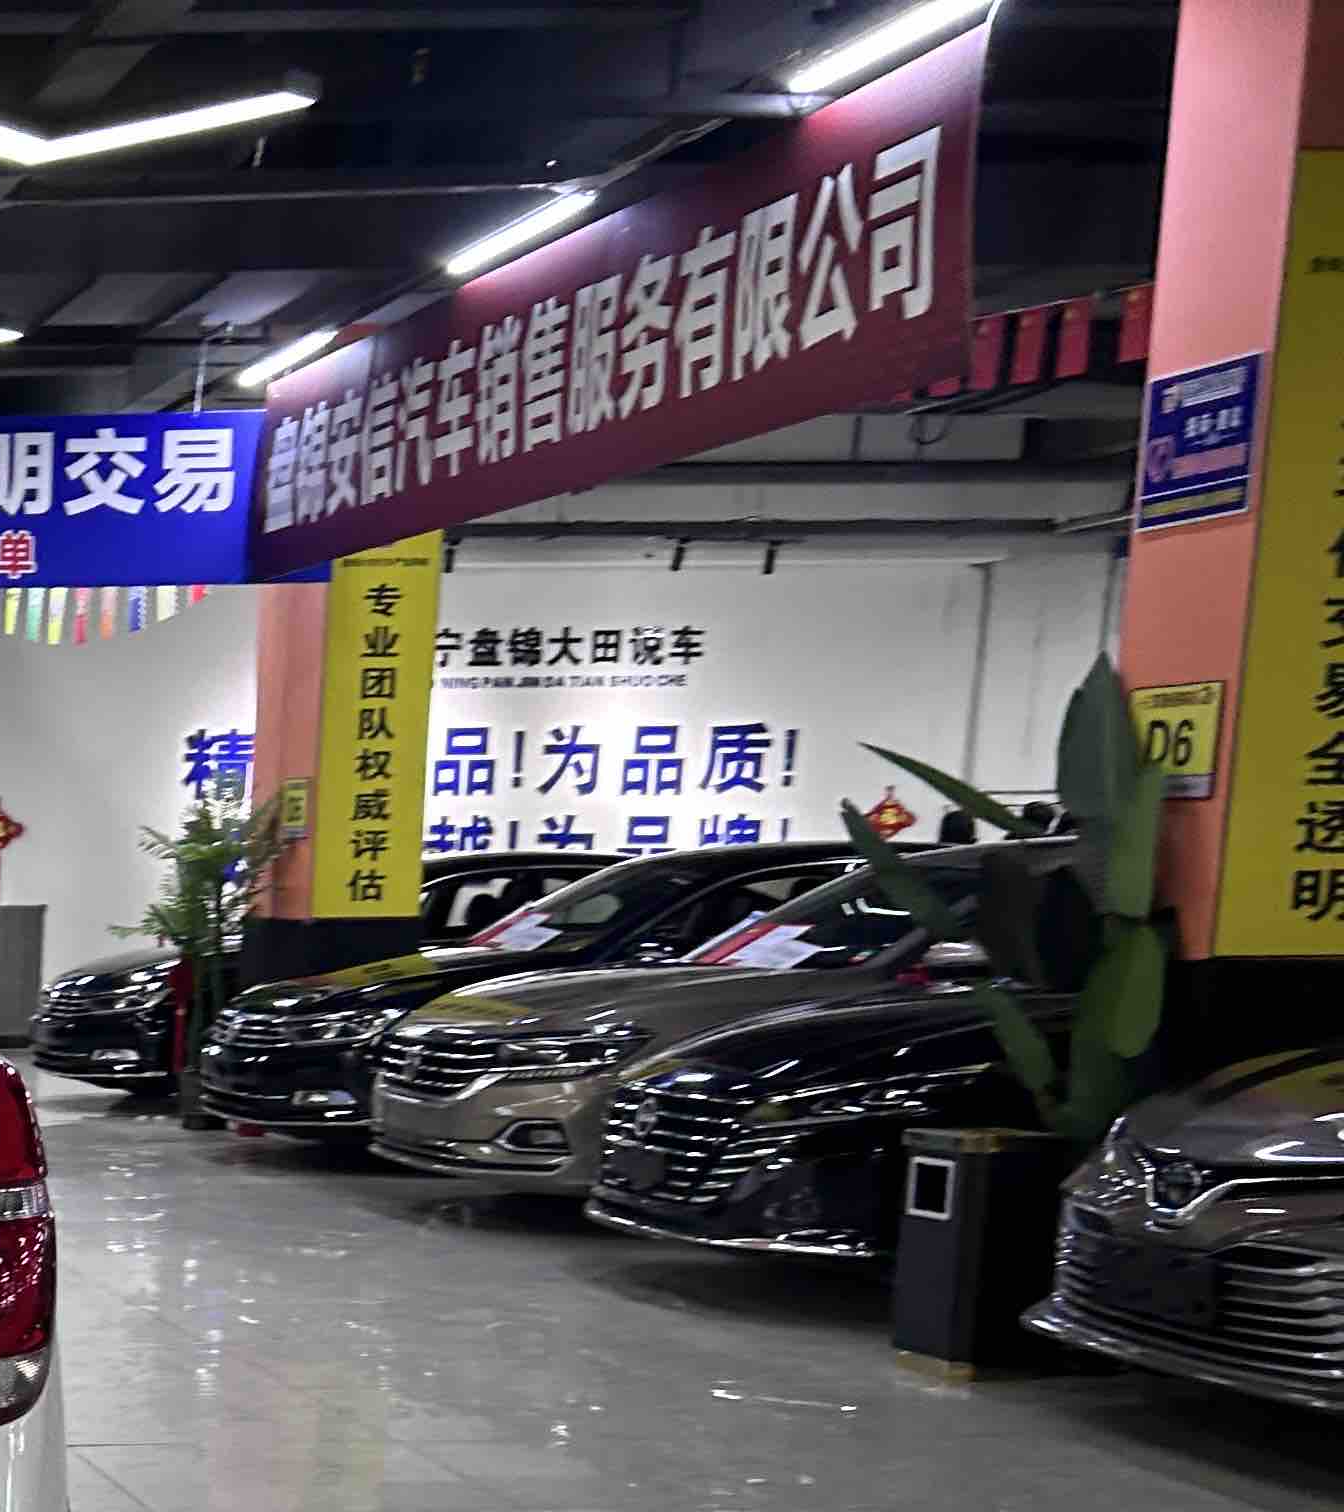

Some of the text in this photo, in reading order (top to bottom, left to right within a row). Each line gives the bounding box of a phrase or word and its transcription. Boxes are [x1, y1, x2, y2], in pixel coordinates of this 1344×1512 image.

[346, 583, 404, 902] 专业团队权威评估
[1142, 719, 1195, 767] D6
